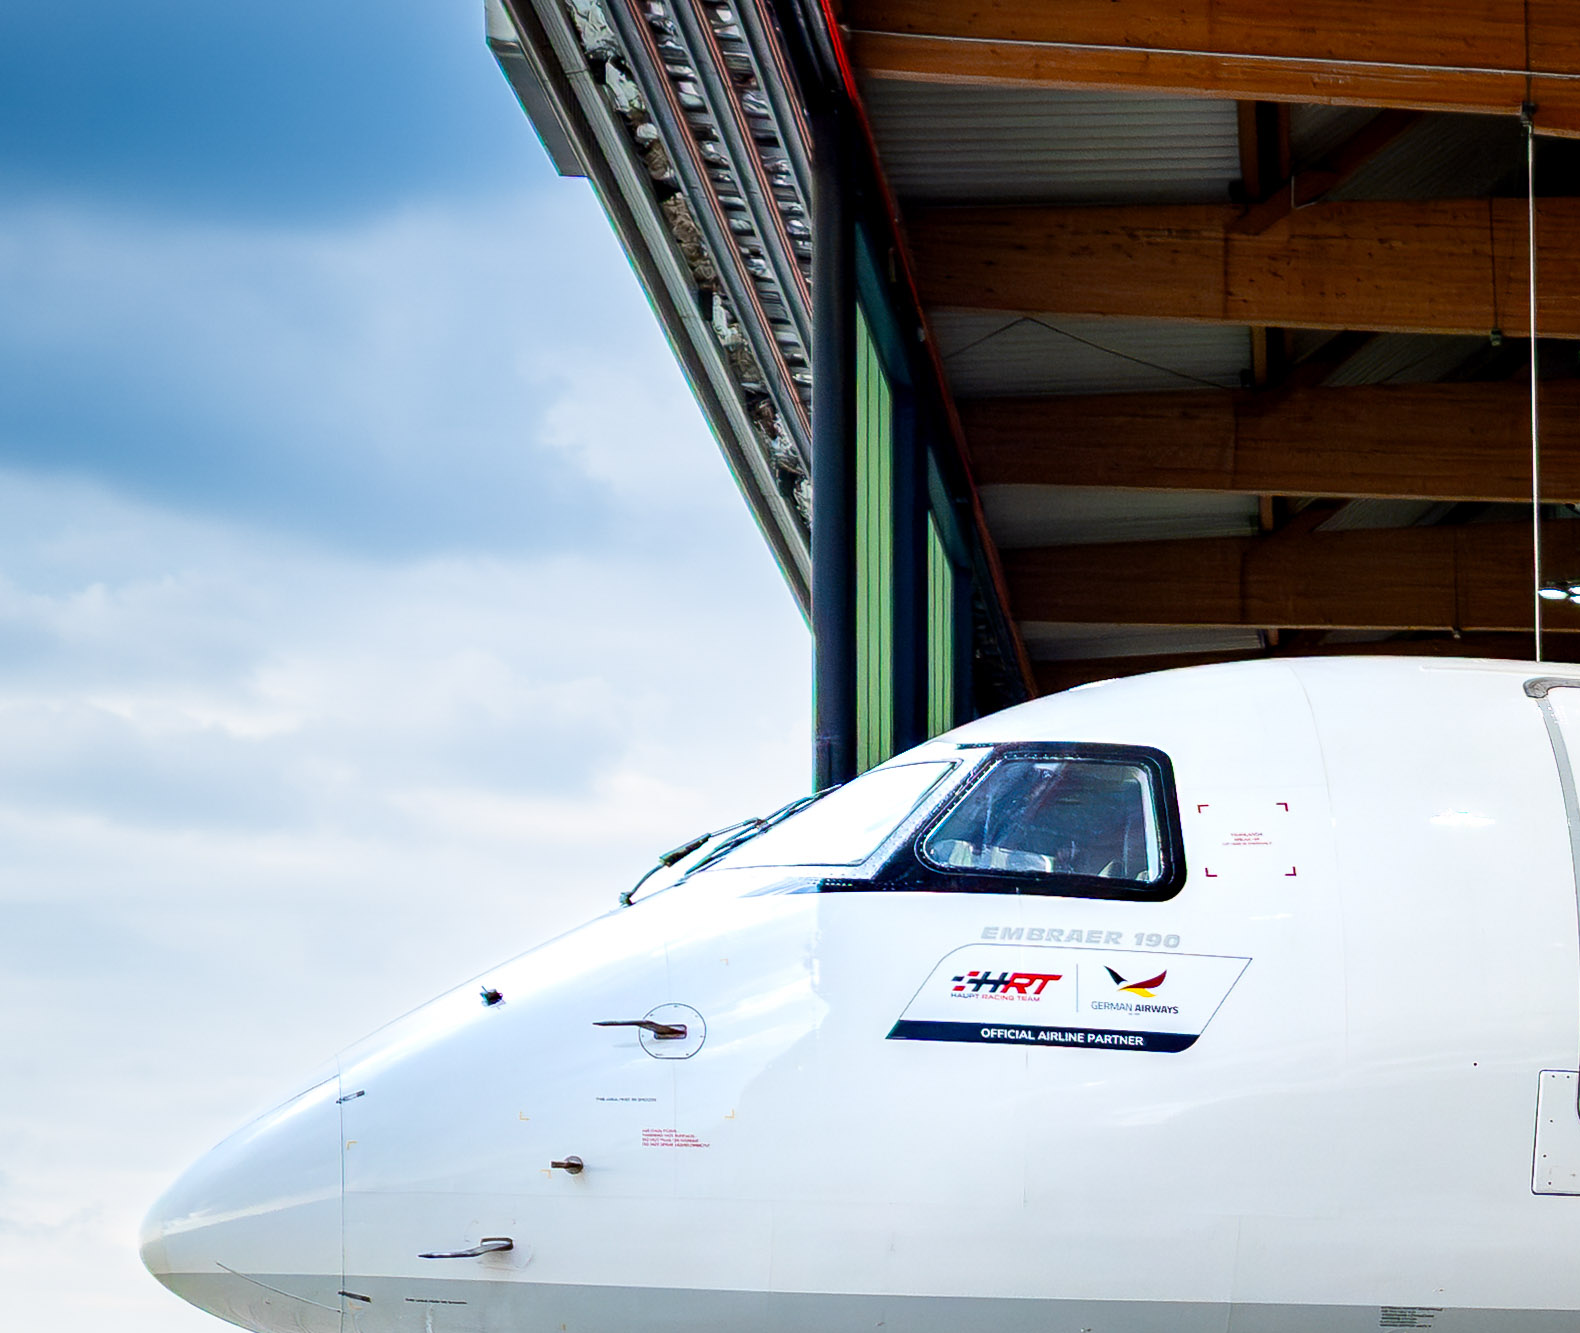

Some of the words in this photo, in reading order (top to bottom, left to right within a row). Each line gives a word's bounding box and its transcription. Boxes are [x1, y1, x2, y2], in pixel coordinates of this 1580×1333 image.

[980, 926, 1123, 946] EMBRAER
[1134, 932, 1181, 948] 190
[967, 971, 1063, 993] HRT
[1091, 1001, 1133, 1013] GERMAN
[1135, 1004, 1179, 1015] AIRWAYS
[980, 1028, 1035, 1041] OFFICIAL
[1037, 1030, 1085, 1043] AIRLINE
[1087, 1033, 1144, 1046] PARTNER
